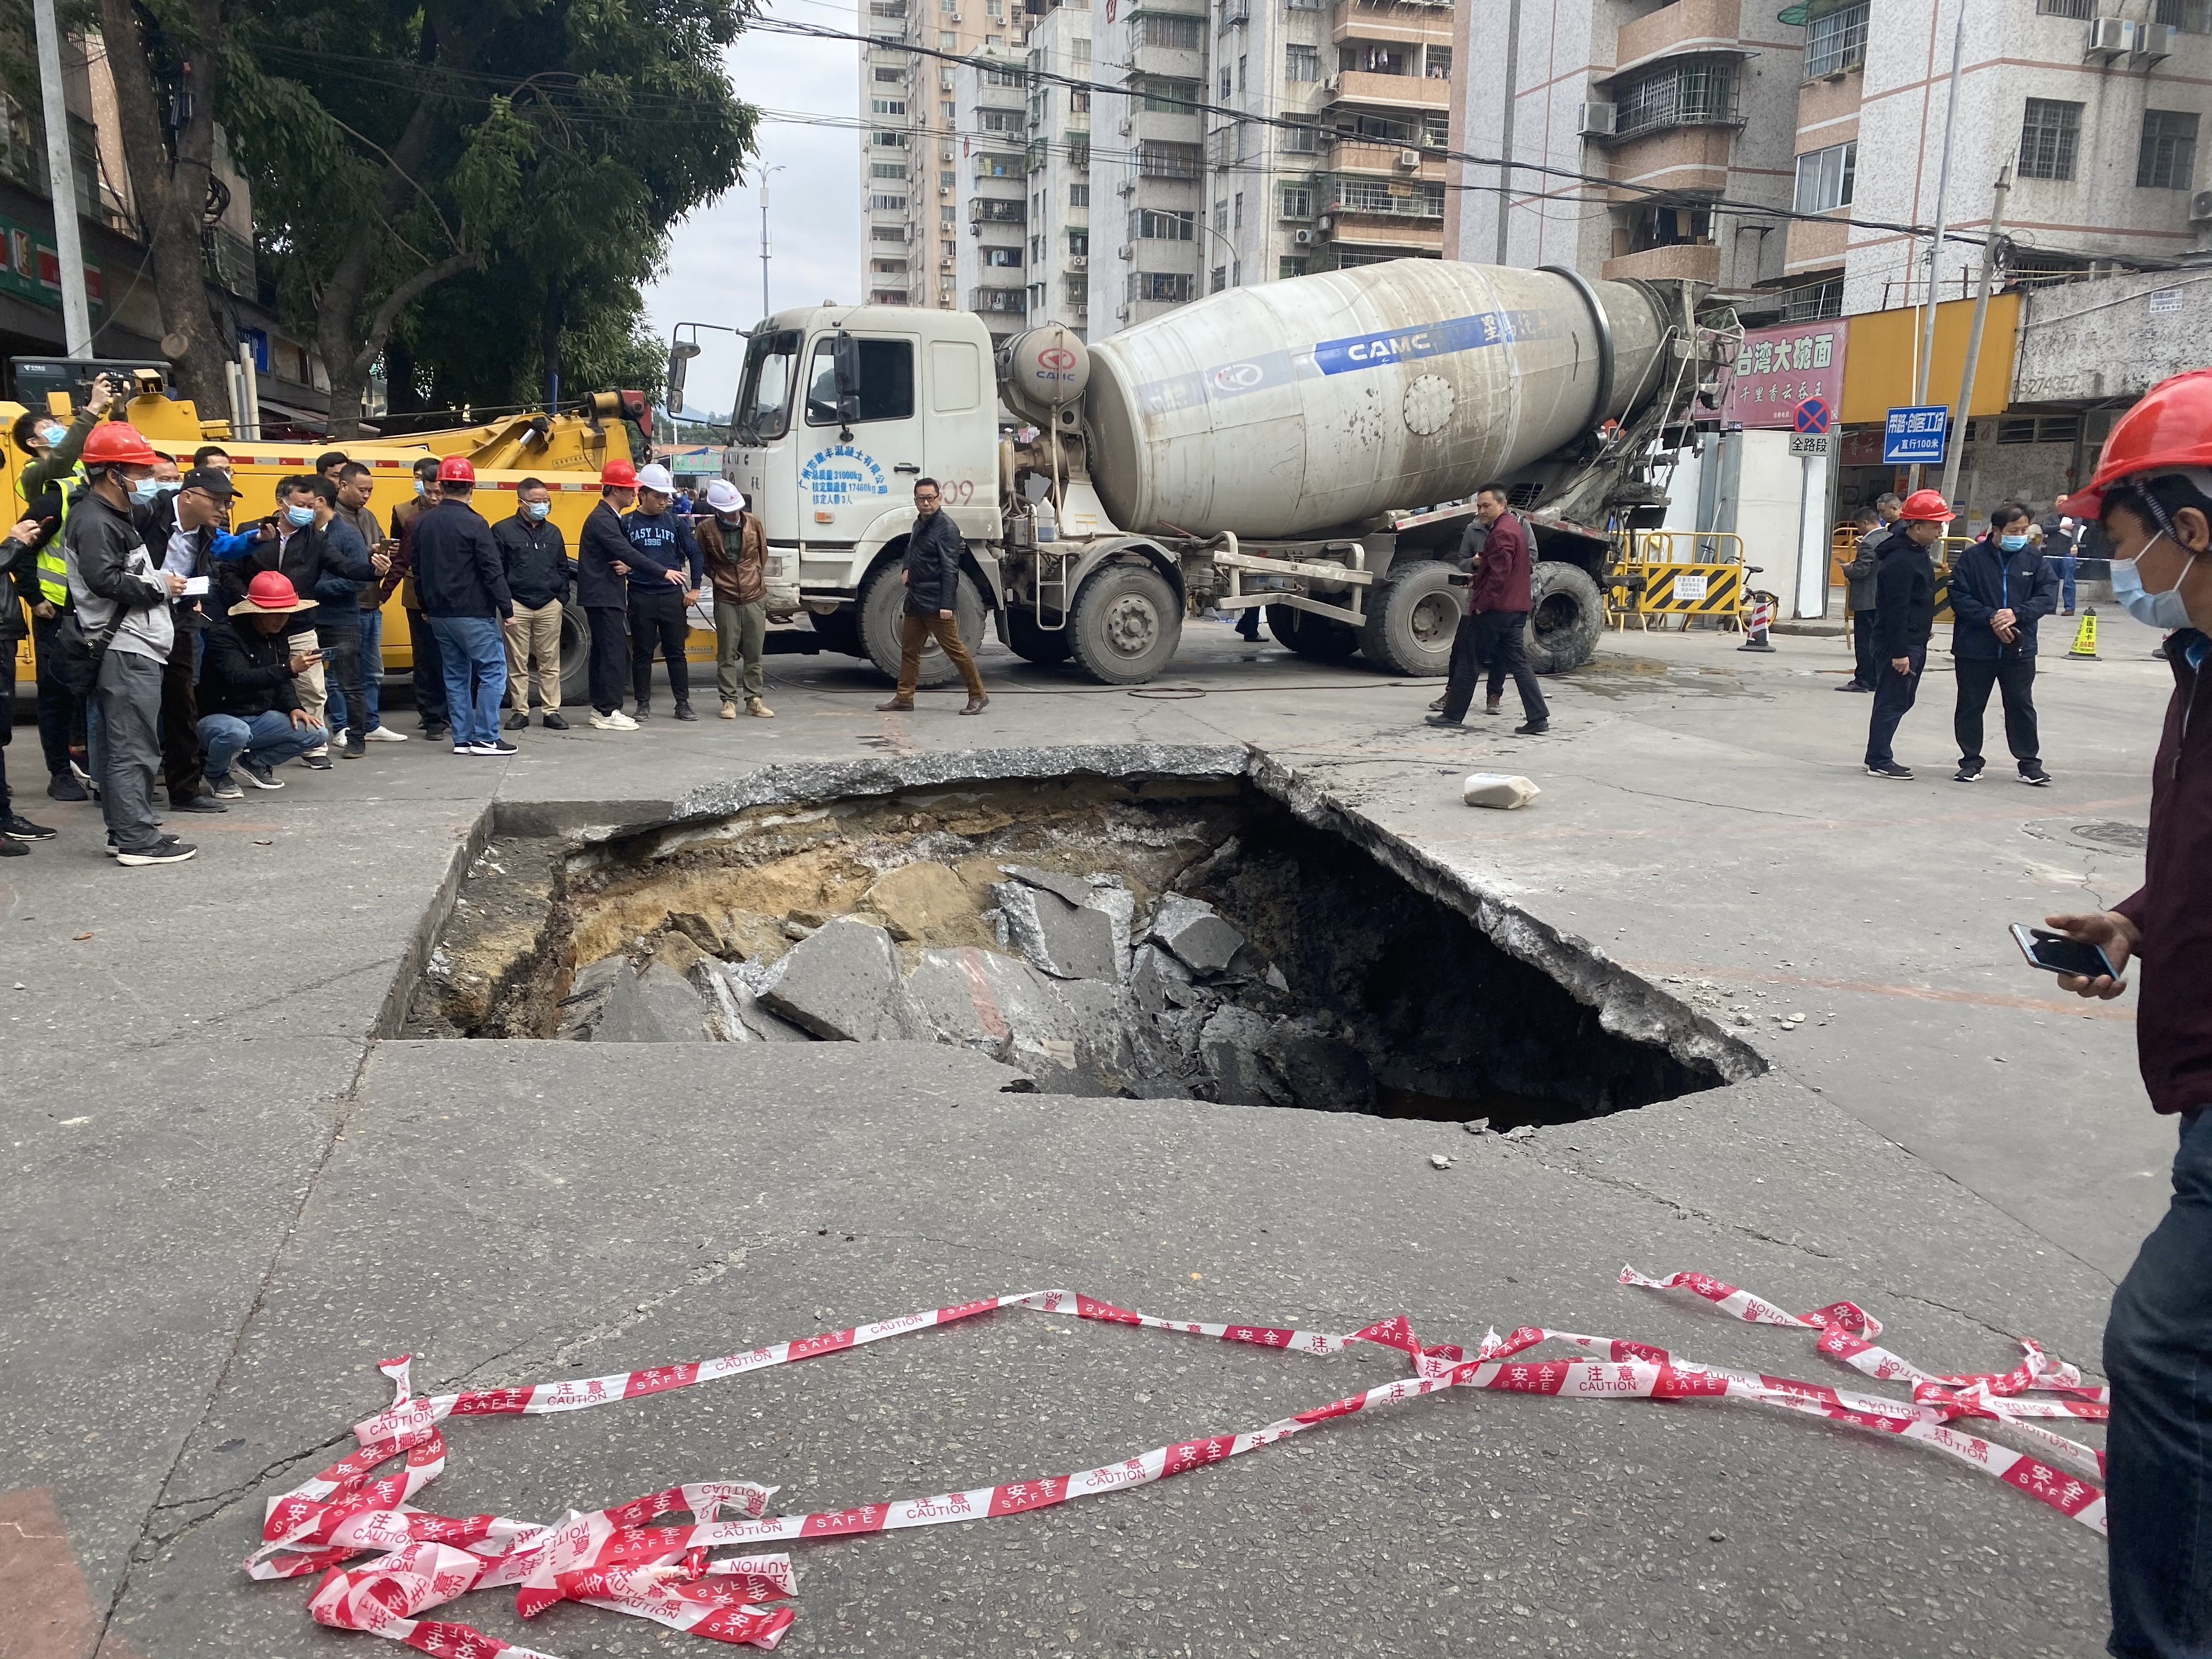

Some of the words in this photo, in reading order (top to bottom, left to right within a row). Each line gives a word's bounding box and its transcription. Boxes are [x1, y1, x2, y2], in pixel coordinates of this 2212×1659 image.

[1348, 333, 1431, 360] CAMC
[1736, 334, 1834, 376] 台湾大碗面
[1739, 380, 1823, 404] 千里香云吞王
[1792, 437, 1827, 453] 全路段
[1901, 438, 1939, 449] 直行100米
[812, 470, 832, 480] 总质量
[834, 471, 862, 481] 31000kg
[849, 483, 876, 494] 17460kg
[813, 494, 840, 505] 核定人数
[630, 527, 652, 543] EASY
[655, 528, 675, 543] LIFE
[871, 1314, 923, 1334] CAUTION
[799, 1334, 846, 1352] SAFE
[1237, 1329, 1280, 1345] 安全
[1370, 1326, 1417, 1346] SAFE
[715, 1352, 772, 1371] CAUTION
[642, 1364, 689, 1380] 安全
[1511, 1365, 1555, 1382] 安全
[1588, 1365, 1635, 1381] 注意
[556, 1380, 606, 1396] 注意
[636, 1372, 687, 1390] SAFE
[1390, 1380, 1434, 1398] 注意
[1502, 1380, 1551, 1391] SAFE
[1579, 1381, 1637, 1391] CAUTION
[1666, 1380, 1717, 1391] SAFE
[463, 1398, 517, 1412] SAFE
[548, 1393, 607, 1406] CAUTION
[370, 1409, 435, 1436] CAUTION
[1179, 1440, 1222, 1463] 安全
[1923, 1433, 1988, 1464] CAUTION
[1086, 1469, 1146, 1487] CAUTION
[2032, 1464, 2085, 1501] 安全
[1007, 1478, 1057, 1499] 安全
[2019, 1472, 2070, 1507] SAFE
[333, 1492, 392, 1517] SAFE
[914, 1493, 968, 1508] 注意
[1002, 1488, 1056, 1509] SAFE
[286, 1503, 307, 1522] 安
[907, 1504, 972, 1519] CAUTION
[369, 1513, 392, 1530] 注
[817, 1514, 873, 1528] SAFE
[624, 1527, 681, 1543] 安全
[713, 1524, 783, 1538] CAUTION
[614, 1536, 676, 1554] SAFE
[730, 1560, 790, 1575] AUTION
